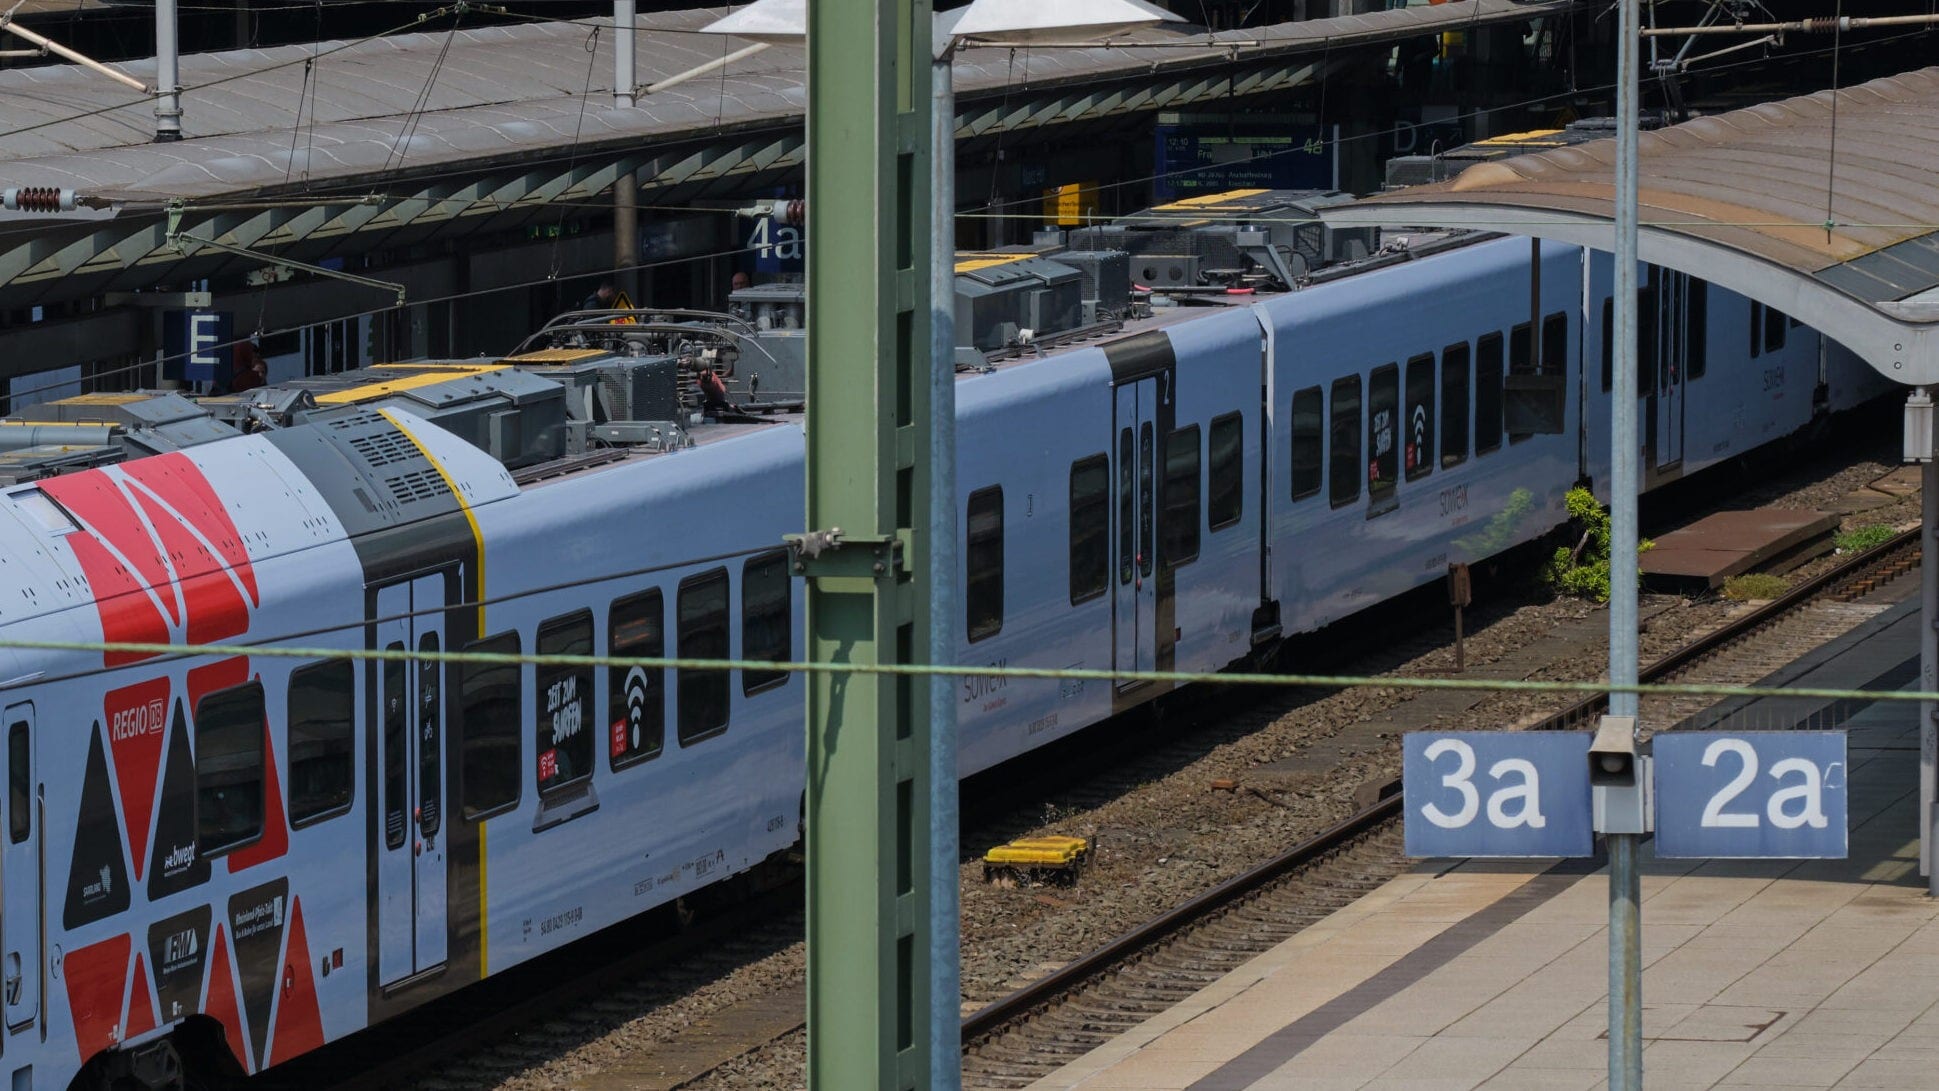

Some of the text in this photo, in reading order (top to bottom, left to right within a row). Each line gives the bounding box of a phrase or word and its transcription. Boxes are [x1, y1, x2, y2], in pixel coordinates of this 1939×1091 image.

[1394, 120, 1417, 152] D
[746, 217, 802, 260] 4a
[190, 315, 220, 364] E
[1163, 369, 1170, 406] 2
[458, 560, 465, 606] 1
[547, 674, 577, 712] ZEIT ZUM
[112, 699, 163, 742] REGIO DB
[552, 696, 582, 745] SURFEN
[1420, 738, 1547, 829] 3a
[1700, 737, 1828, 829] 2a
[173, 840, 196, 867] bwegt
